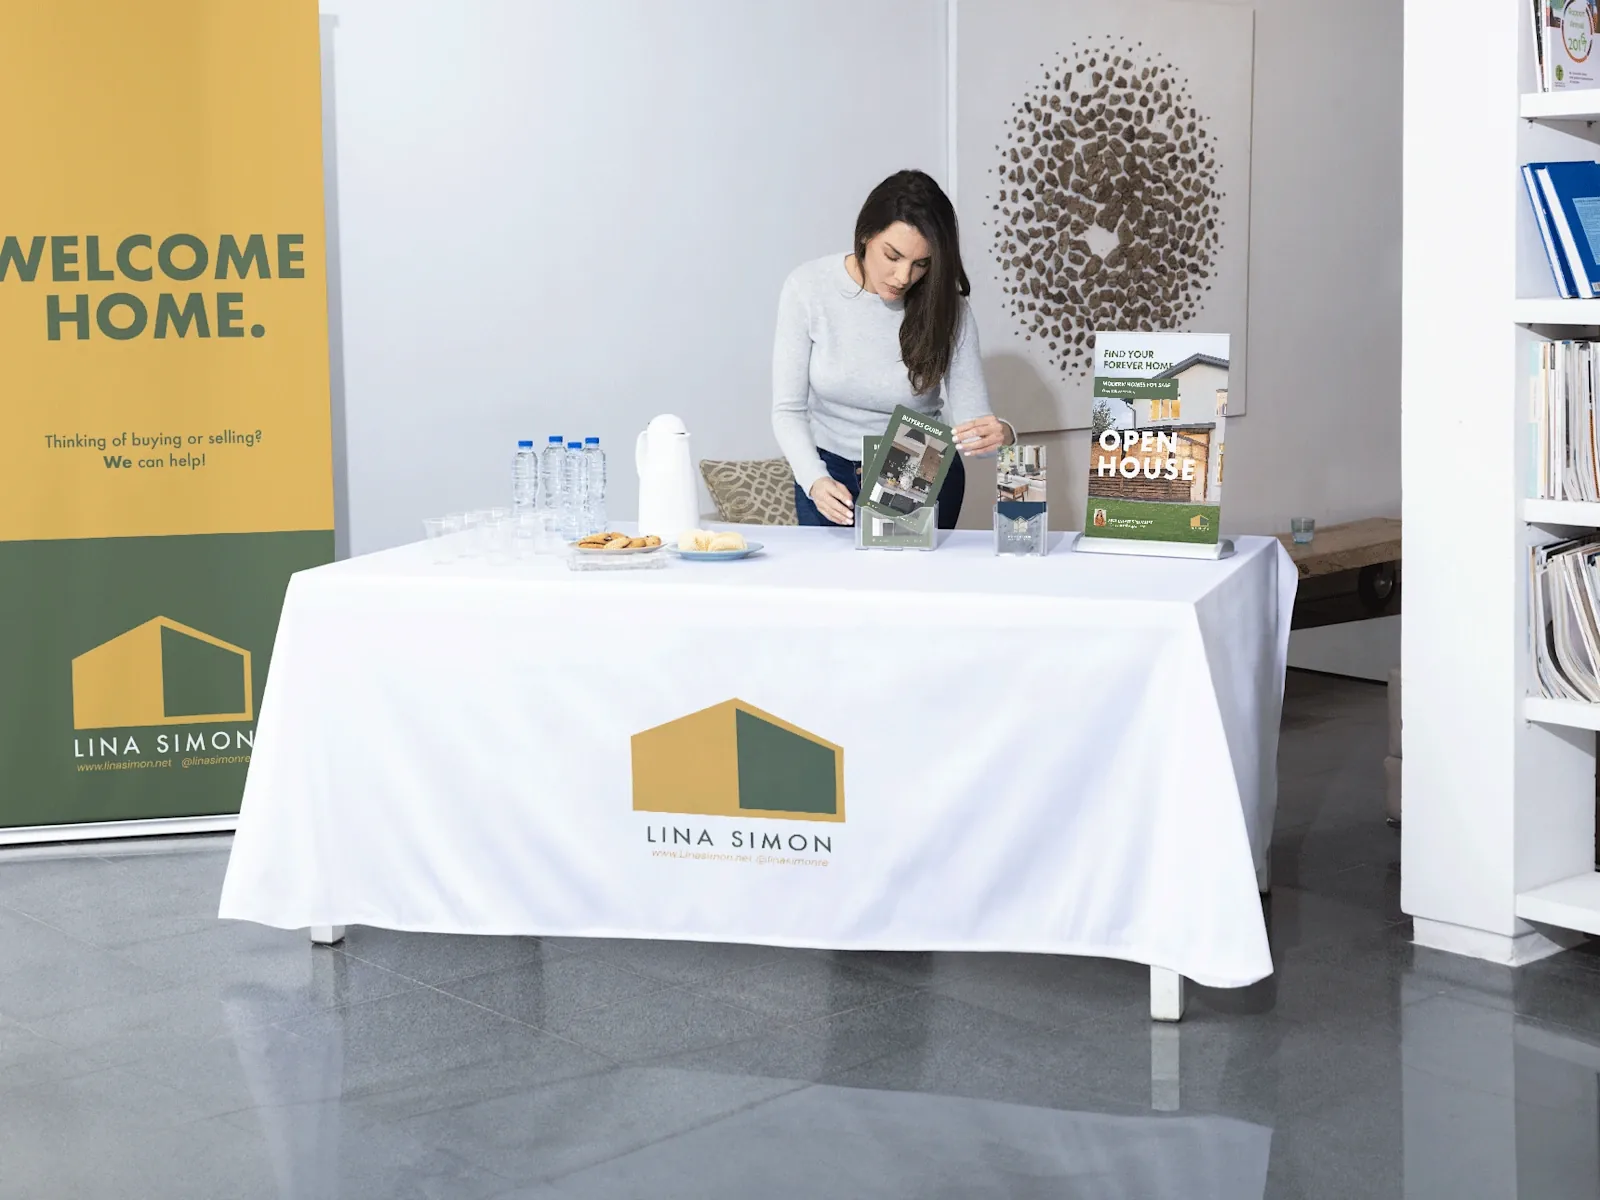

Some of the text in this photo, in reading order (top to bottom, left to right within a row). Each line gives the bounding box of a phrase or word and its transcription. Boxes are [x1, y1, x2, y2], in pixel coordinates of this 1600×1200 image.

[0, 233, 305, 282] WELCOME
[46, 292, 266, 341] HOME.
[1103, 349, 1154, 359] FIND YOUR
[1103, 360, 1143, 370] FOREVER
[902, 414, 944, 436] BUYERS GUIDE
[45, 430, 262, 451] Thinking of buying or selling?
[1098, 429, 1178, 454] OPEN
[103, 453, 206, 471] We can help!
[1097, 455, 1196, 481] HOUSE
[74, 730, 254, 758] LINA SIMON
[77, 759, 172, 772] www.linasimon.net
[646, 825, 832, 853] LINA SIMON
